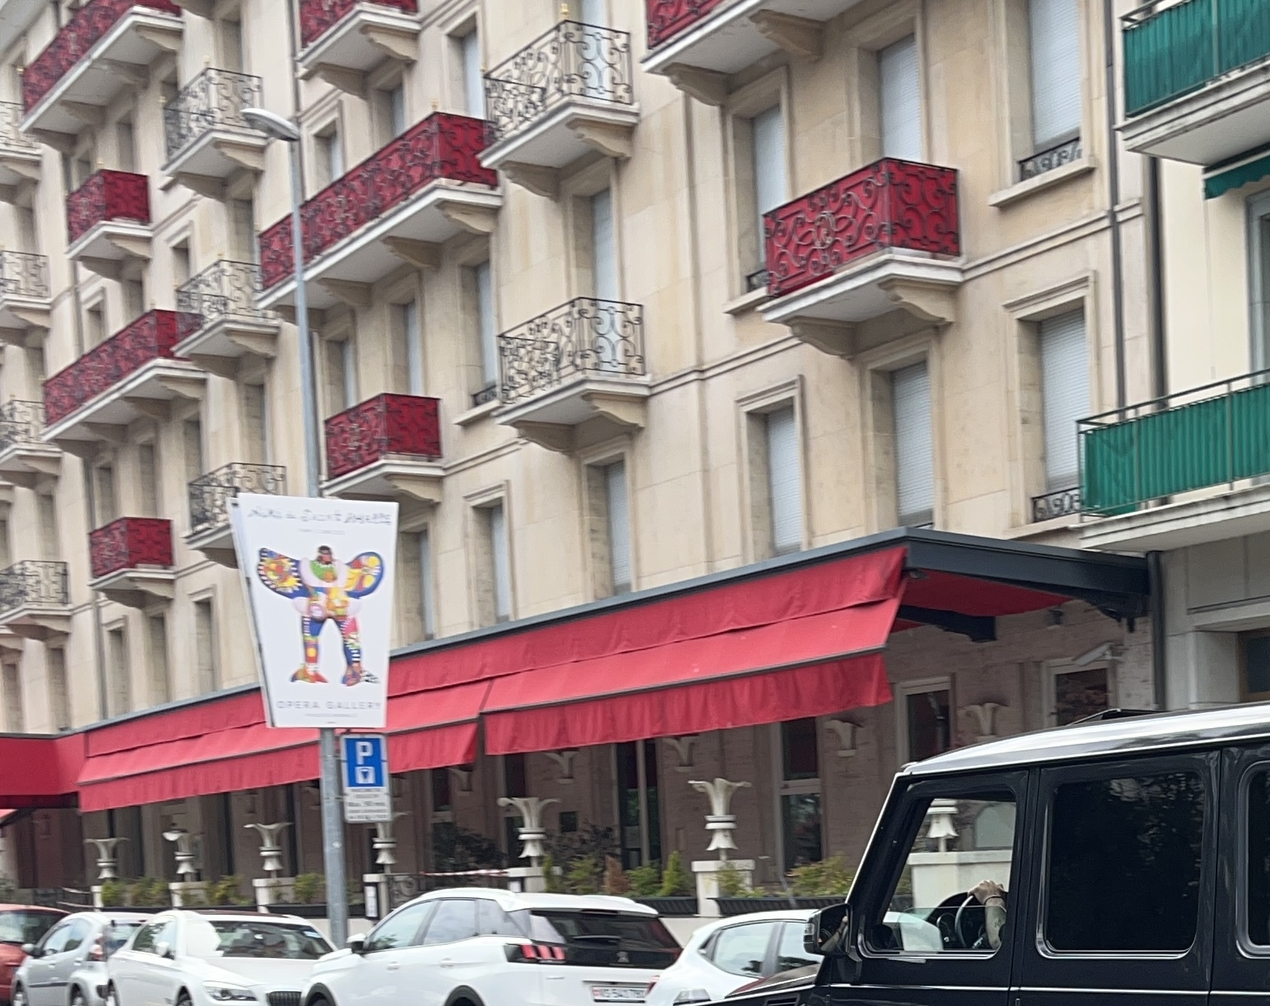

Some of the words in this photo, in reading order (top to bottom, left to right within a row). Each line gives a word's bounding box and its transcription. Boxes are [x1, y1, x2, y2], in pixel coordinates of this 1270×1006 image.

[276, 700, 320, 709] OPERA
[325, 701, 382, 710] GALLERY
[355, 741, 374, 765] P
